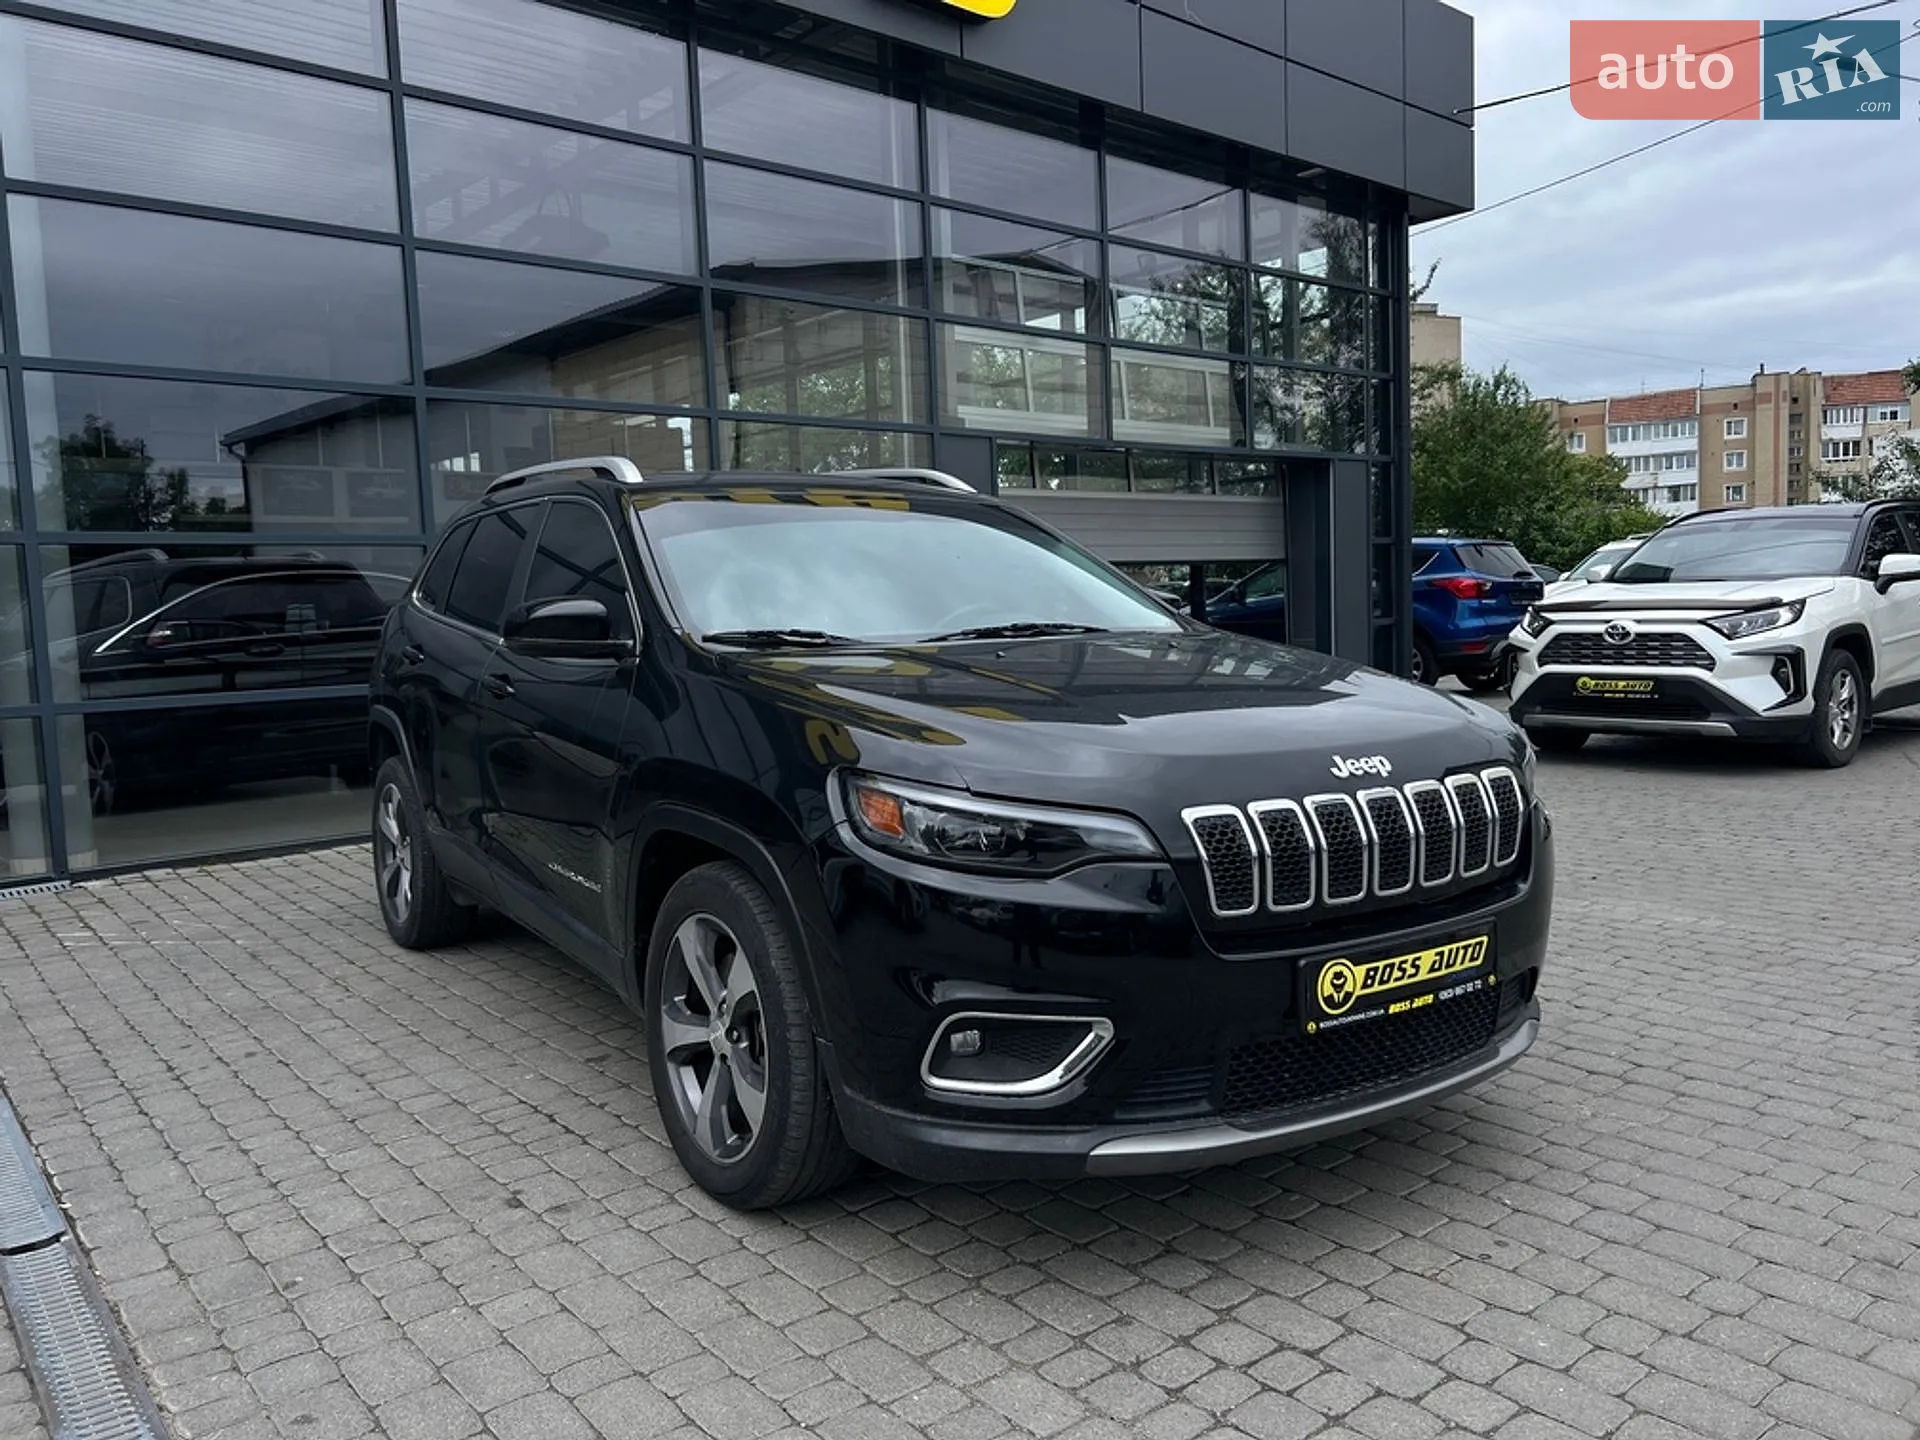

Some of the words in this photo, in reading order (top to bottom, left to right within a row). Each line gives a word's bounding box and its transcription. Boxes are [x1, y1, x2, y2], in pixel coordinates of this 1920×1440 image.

[1329, 755, 1392, 778] Jeep
[1361, 956, 1422, 990] BOSS
[1427, 941, 1484, 974] AUTO
